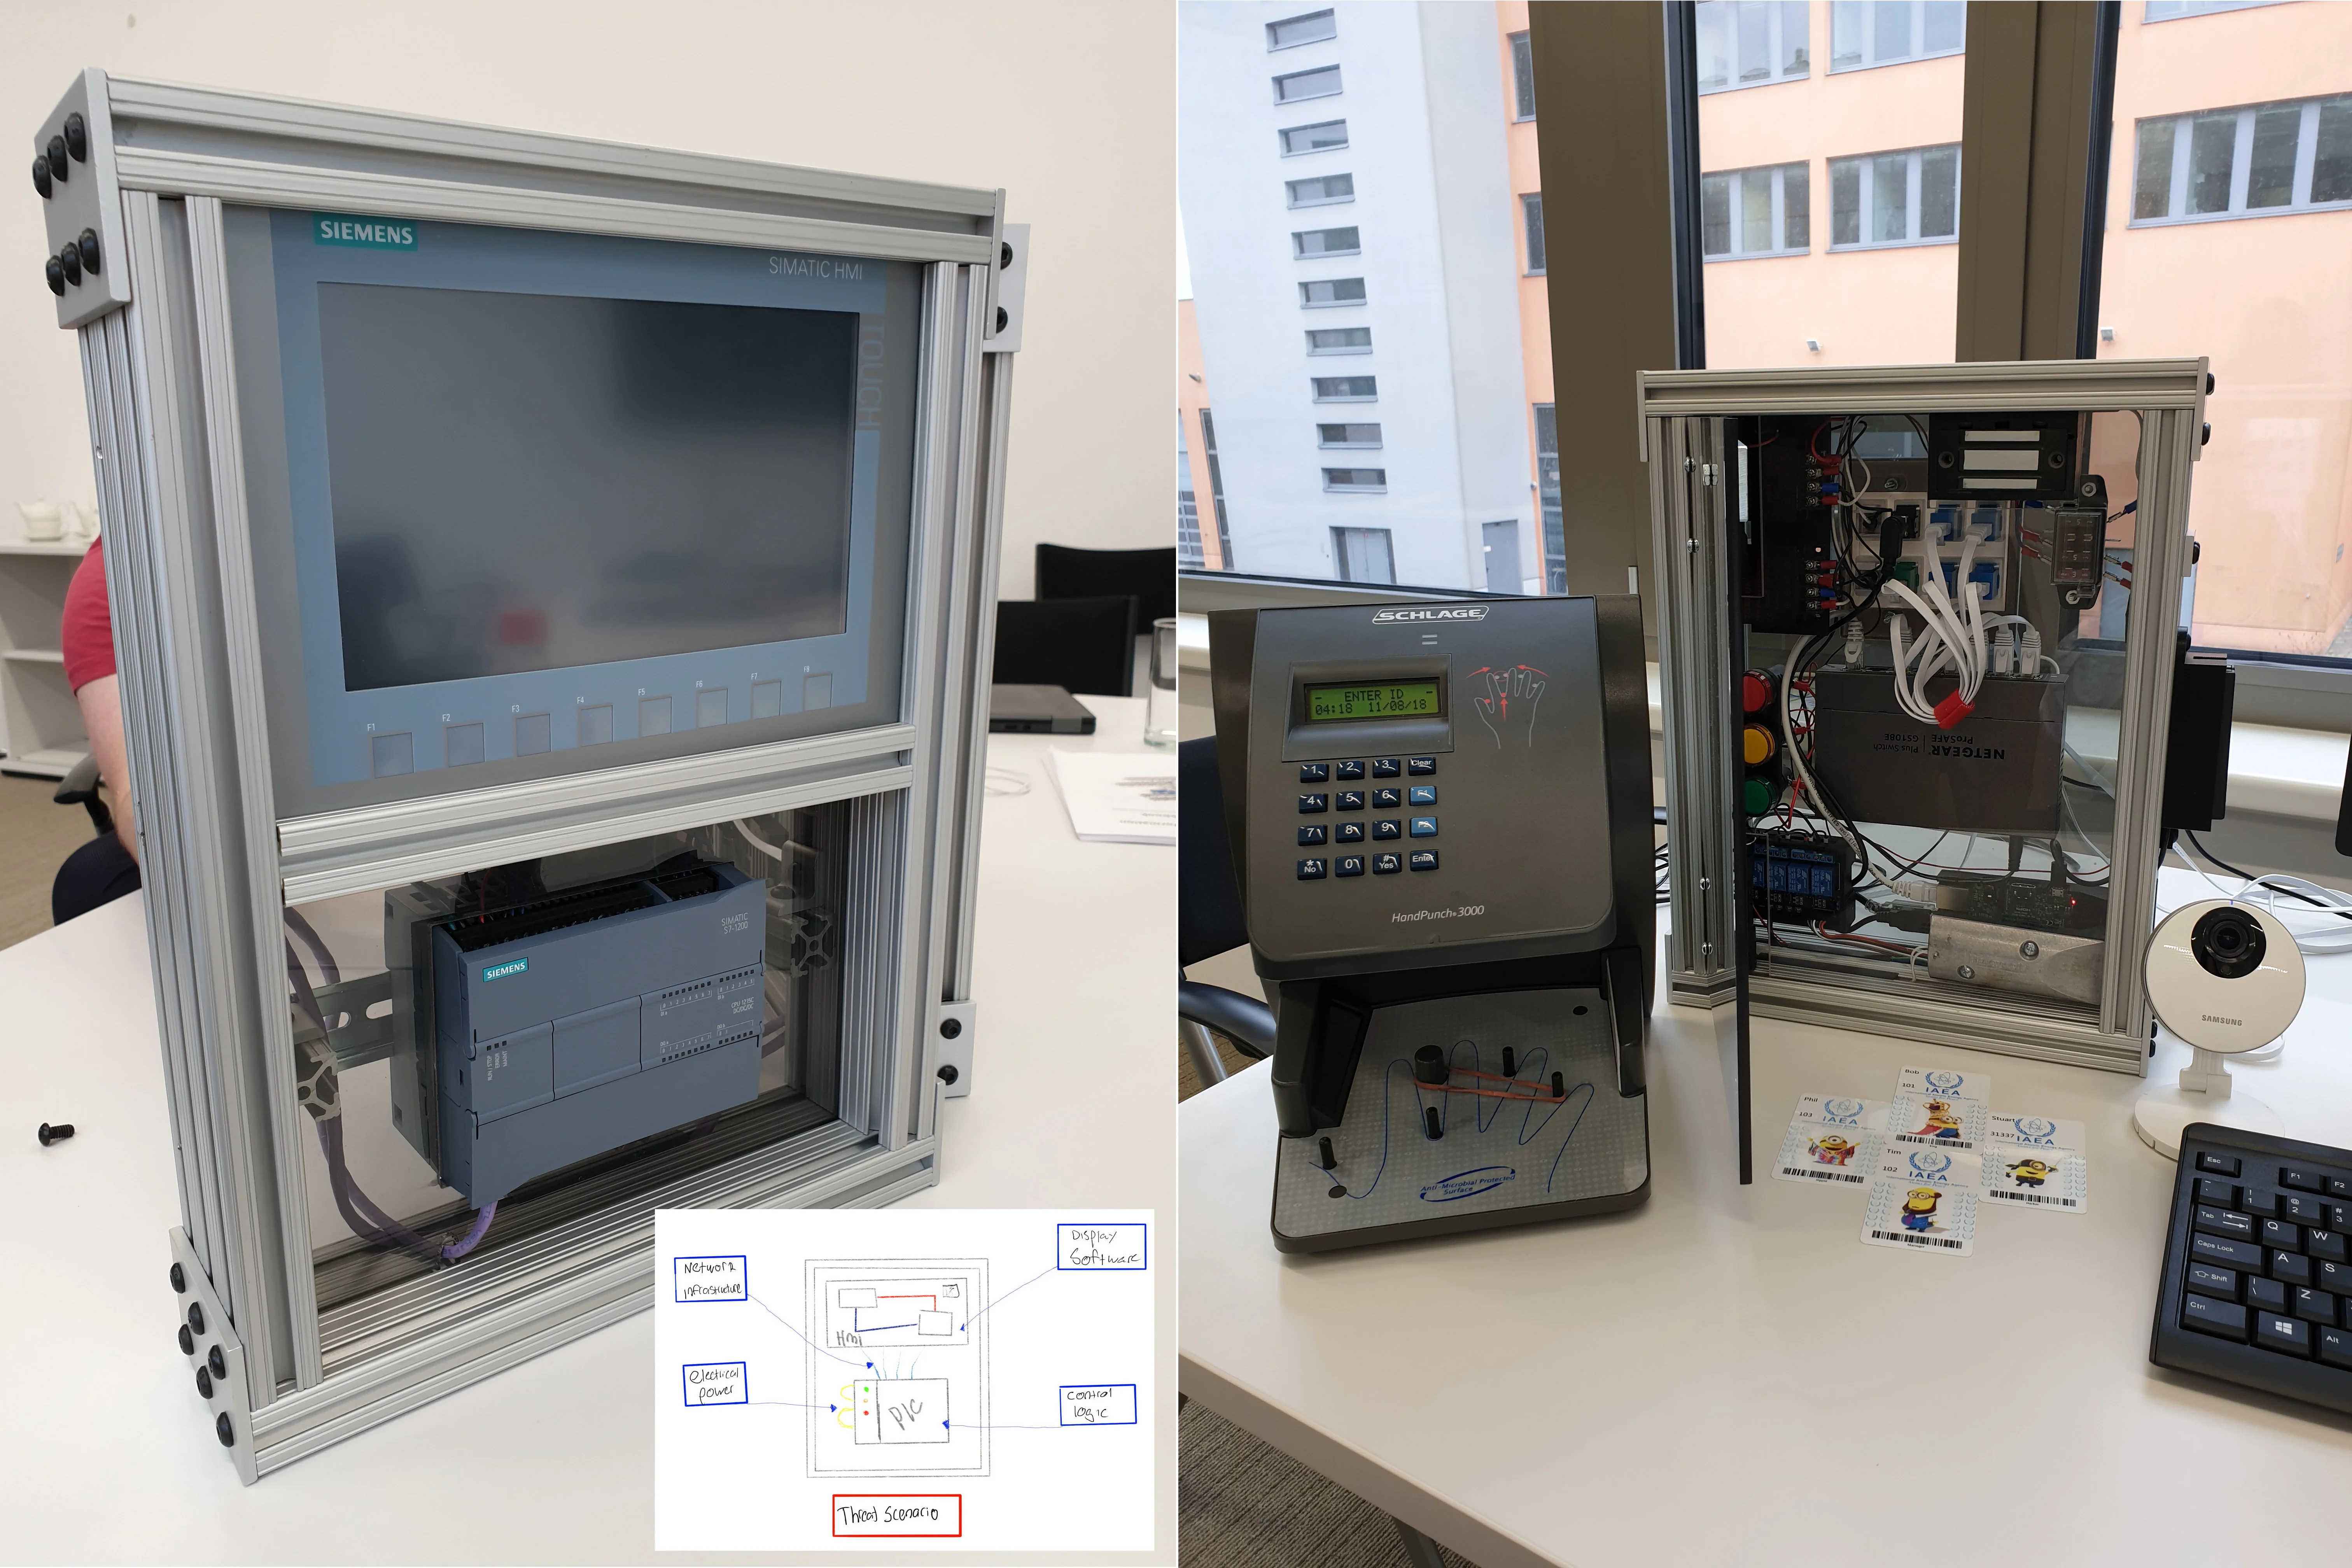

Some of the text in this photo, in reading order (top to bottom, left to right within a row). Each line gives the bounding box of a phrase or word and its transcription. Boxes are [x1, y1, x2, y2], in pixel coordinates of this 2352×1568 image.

[320, 220, 413, 244] SIEMENS
[769, 256, 862, 280] SIMATIC HMI
[858, 320, 886, 427] TOUCH
[1379, 609, 1482, 621] SCHLAGE
[1344, 689, 1404, 702] ENTER ID
[512, 705, 520, 713] F3
[1316, 699, 1426, 715] 04:18 11/08/18
[442, 714, 450, 722] F2
[367, 723, 375, 732] F1
[1885, 733, 1919, 742] GS108E
[1932, 734, 1973, 744] ProSAFE
[1874, 744, 1899, 752] Switch
[1931, 745, 2005, 760] NETGEAR
[1346, 762, 1354, 770] 2
[1382, 760, 1389, 768] 3
[1311, 765, 1316, 774] 1
[1346, 793, 1354, 802] 5
[1382, 790, 1390, 799] 6
[1307, 796, 1315, 805] 4
[1822, 805, 1839, 827] VERIFIED
[1346, 825, 1353, 834] 8
[1381, 822, 1389, 831] 9
[1307, 828, 1314, 837] 7
[1345, 859, 1353, 869] 0
[1392, 905, 1484, 923] HandPunch 3000
[721, 912, 748, 926] SIMATIC
[724, 921, 748, 934] S7-1200
[487, 962, 525, 979] SIEMENS
[742, 997, 754, 1005] 1215C
[733, 1003, 754, 1014] DC/DC/DC
[2202, 1014, 2242, 1026] SAMSUNG
[1926, 1087, 1960, 1096] IAEA
[1823, 1116, 1857, 1125] IAEA
[2017, 1136, 2054, 1145] IAEA
[1909, 1171, 1947, 1181] IAEA
[1420, 1175, 1516, 1192] Anti-Microbial Protected
[1443, 1187, 1473, 1195] Surface
[2267, 1222, 2278, 1231] Q
[2313, 1230, 2328, 1240] W
[2278, 1253, 2289, 1262] A
[2325, 1264, 2335, 1272] S
[2301, 1288, 2311, 1300] Z
[2190, 1302, 2205, 1310] Ctrl
[2326, 1335, 2339, 1344] Alt
[837, 1505, 938, 1525] Threat Scenario
